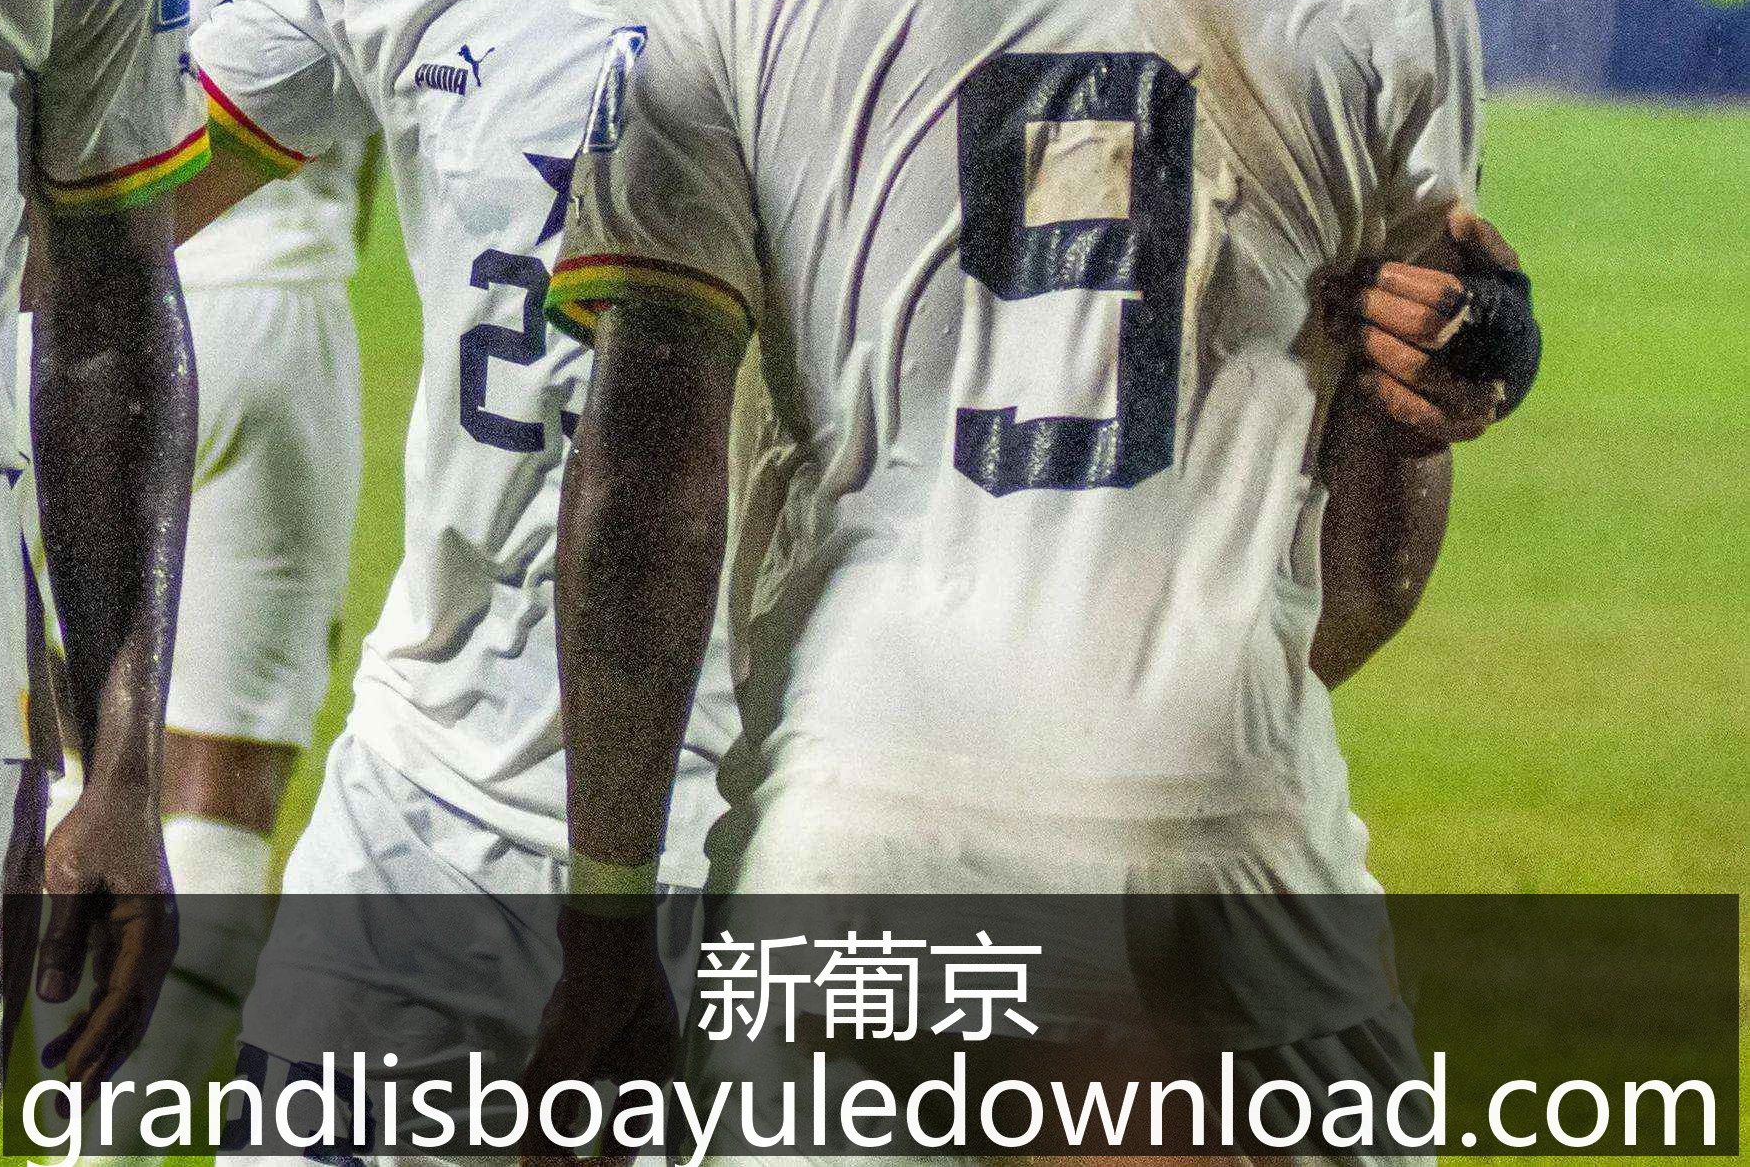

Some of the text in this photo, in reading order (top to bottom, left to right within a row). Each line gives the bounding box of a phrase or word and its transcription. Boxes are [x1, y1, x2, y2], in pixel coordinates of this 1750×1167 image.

[414, 63, 468, 97] PUMA
[460, 248, 581, 452] 2
[954, 51, 1196, 497] 9
